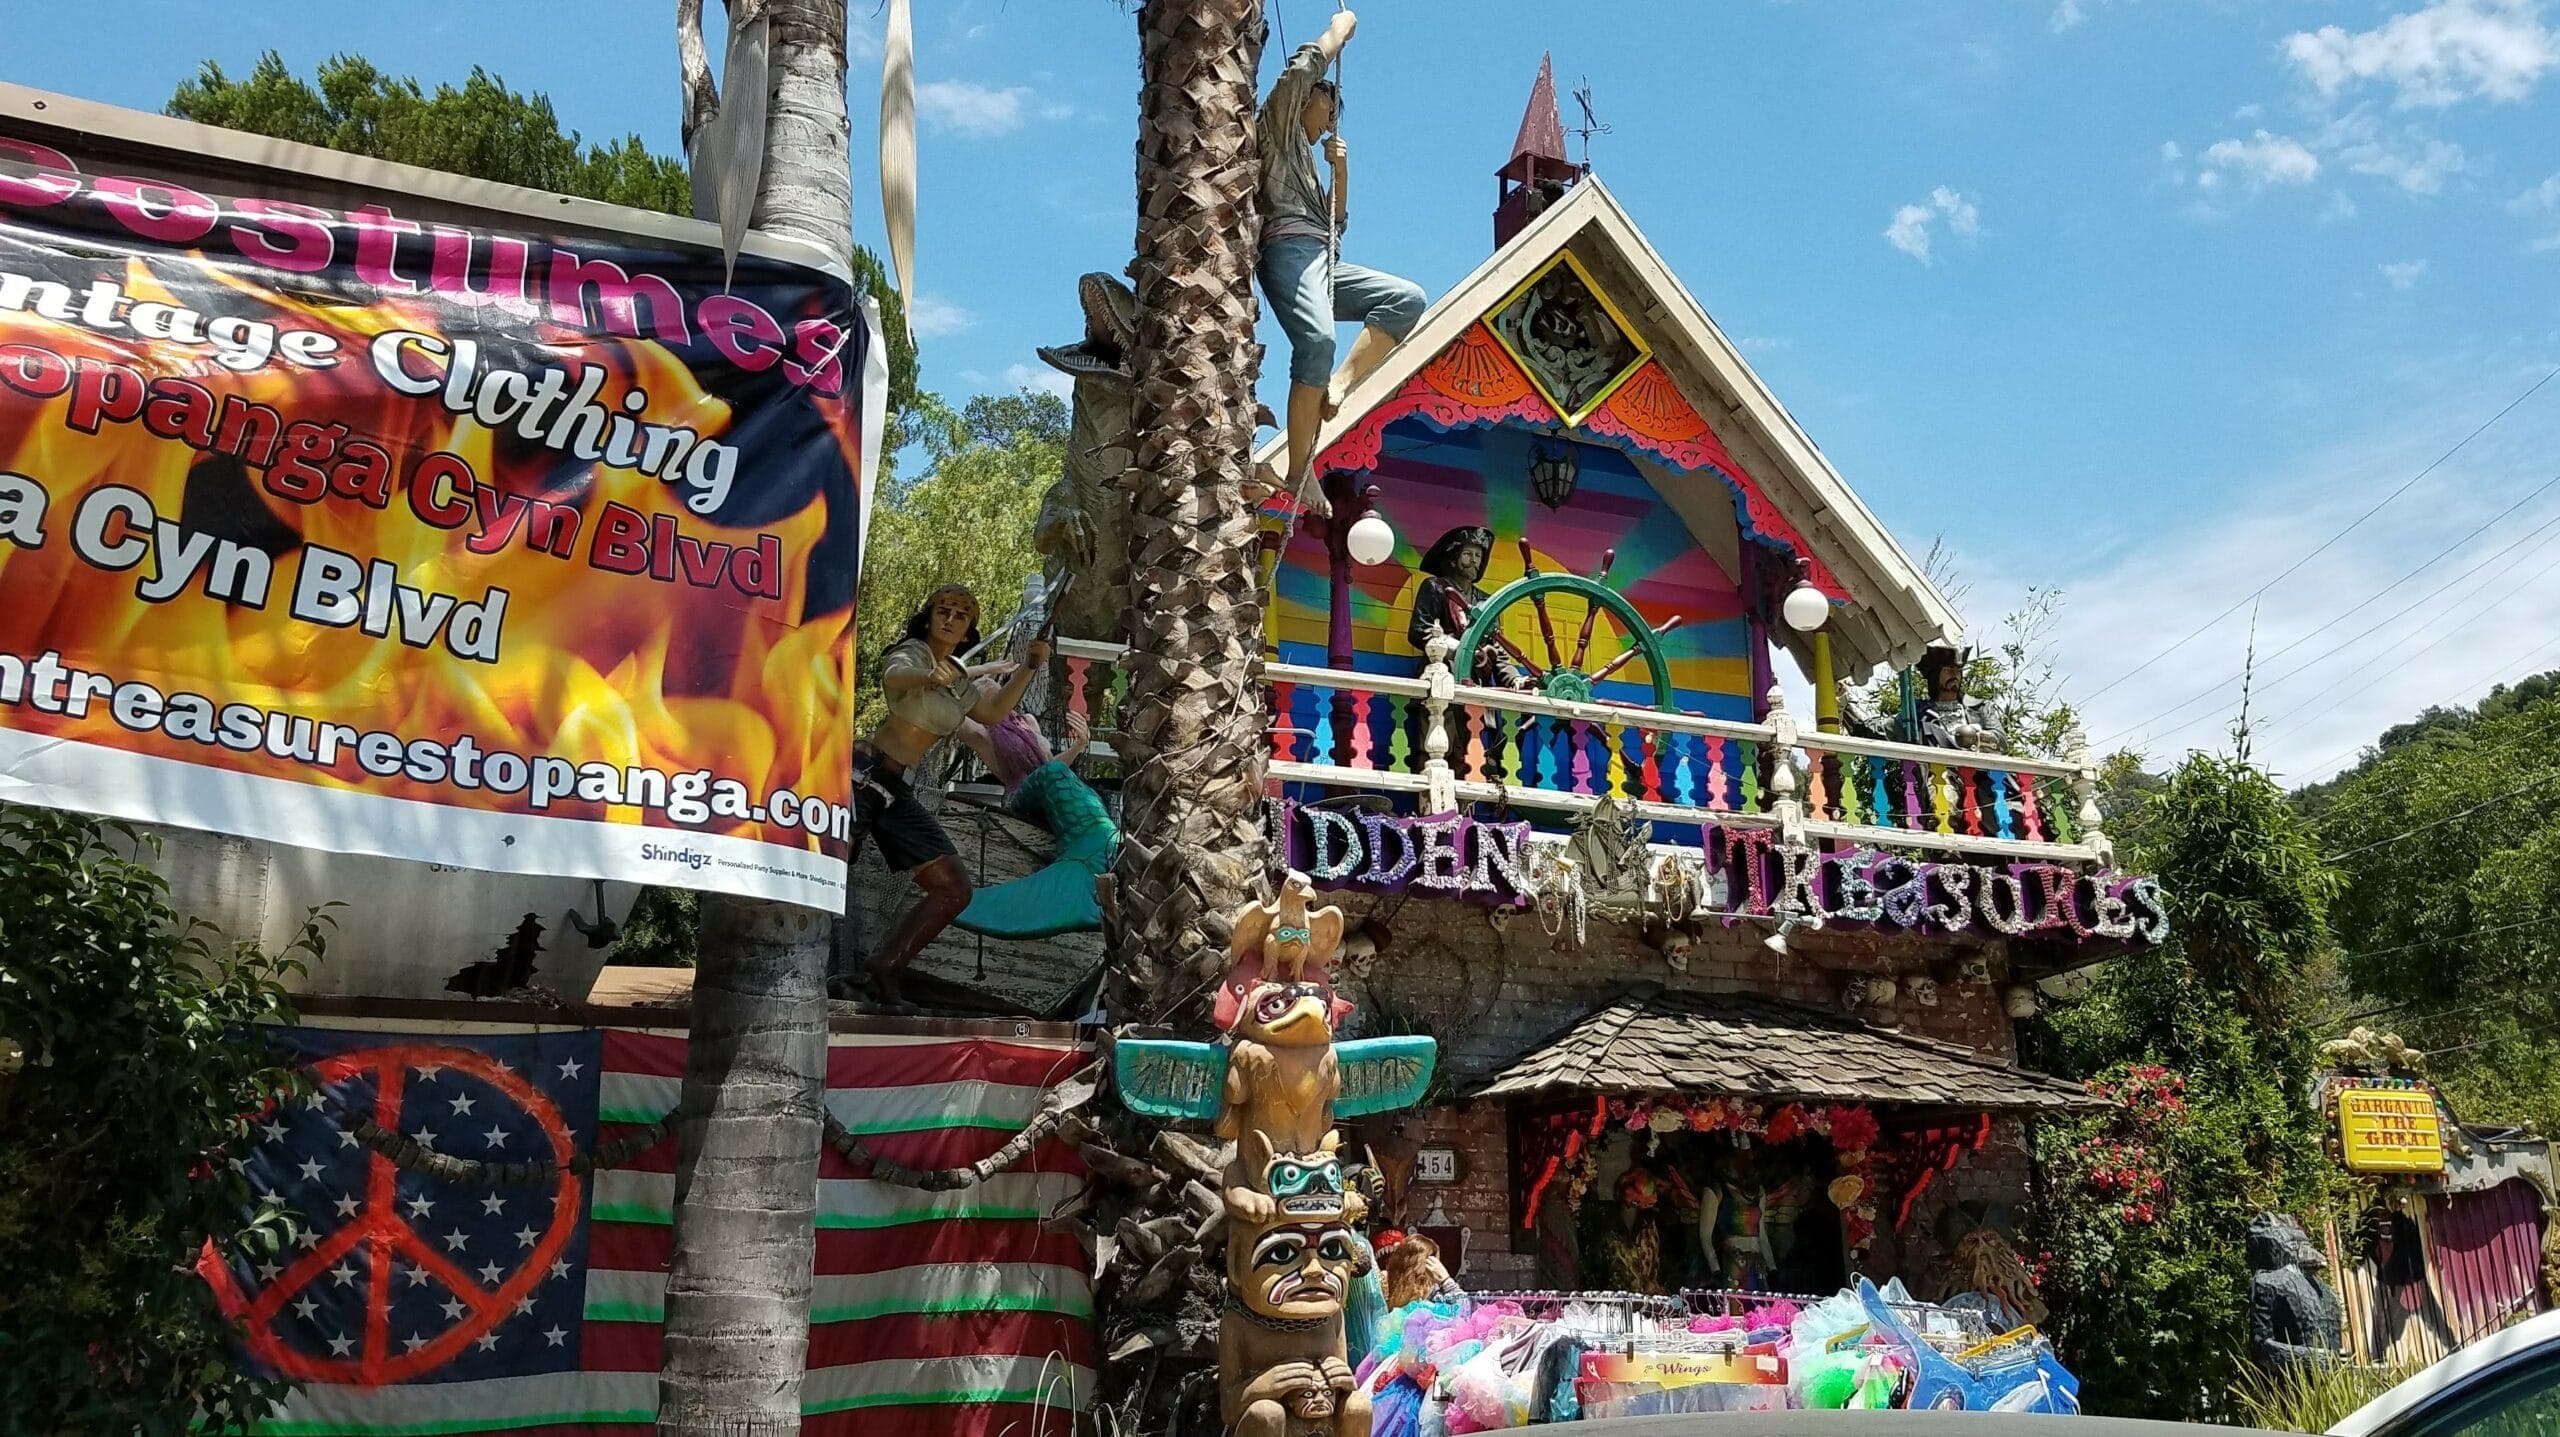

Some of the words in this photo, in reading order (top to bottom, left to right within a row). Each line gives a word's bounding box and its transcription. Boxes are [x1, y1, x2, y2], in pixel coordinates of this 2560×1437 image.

[0, 136, 844, 394] Costumes
[369, 330, 740, 514] Clothing
[0, 343, 391, 510] opanga
[407, 451, 583, 559] Cyn
[589, 502, 783, 600] Blvd
[70, 483, 275, 609] Cyn
[289, 541, 511, 664] Blvd
[641, 843, 712, 870] Shindigz
[717, 858, 753, 871] Personalized
[754, 864, 769, 874] Party
[769, 866, 791, 878] Supplies
[2381, 1115, 2417, 1130] THE
[2366, 1131, 2430, 1147] GREAT
[1655, 1362, 1712, 1377] Wings
